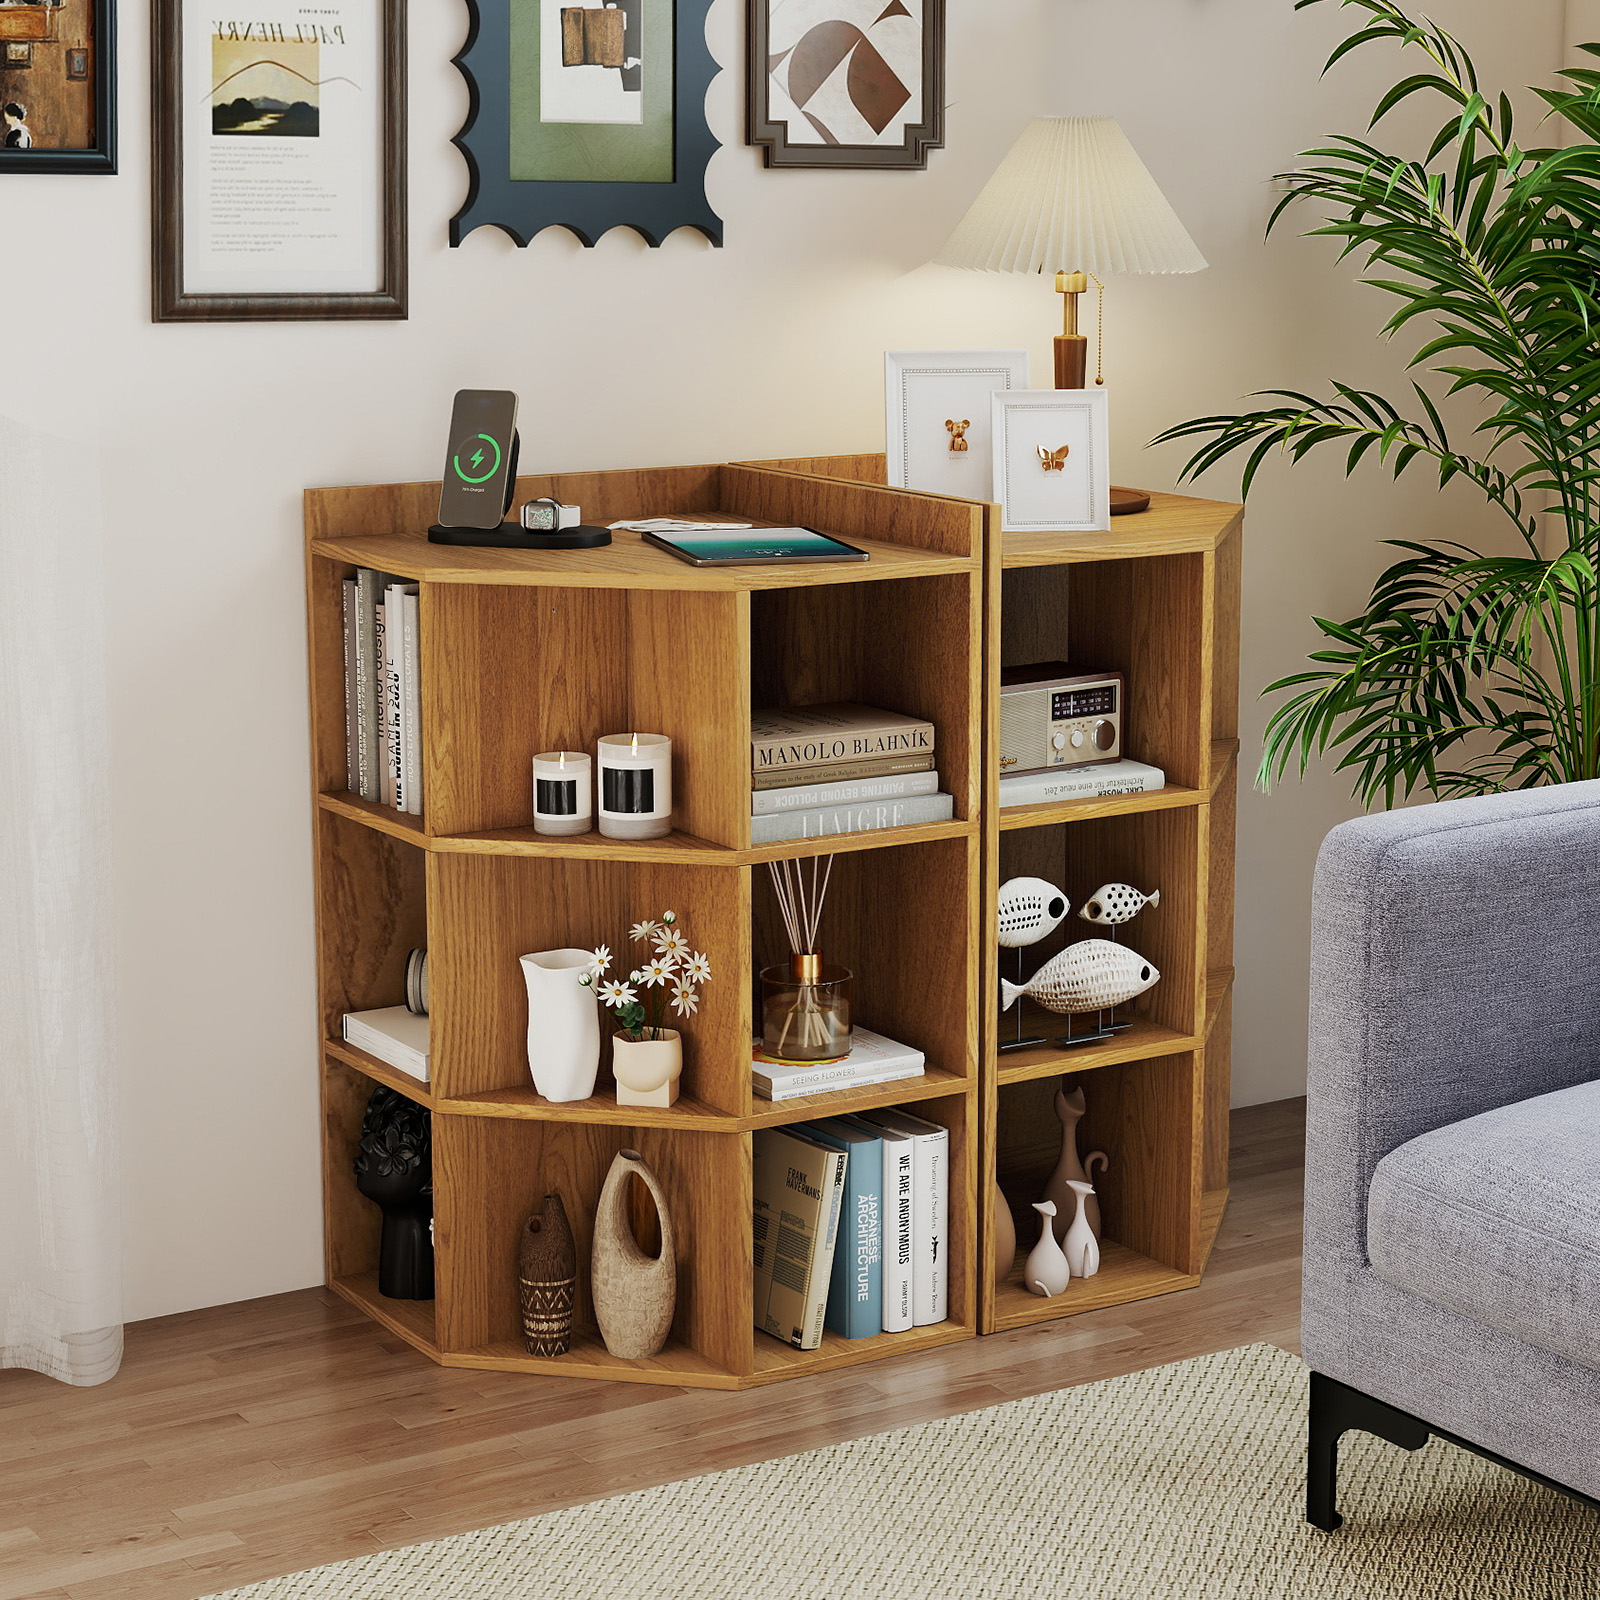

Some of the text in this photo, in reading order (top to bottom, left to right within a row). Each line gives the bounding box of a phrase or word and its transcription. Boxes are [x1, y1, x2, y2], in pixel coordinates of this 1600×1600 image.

[360, 647, 368, 710] arrangement
[404, 625, 414, 783] HOUSEHOLD DECORATES
[759, 729, 930, 767] MANOLO BLAHNÍK
[861, 782, 904, 797] PAINTING
[1043, 786, 1059, 796] Zeit
[1077, 783, 1093, 792] eine
[1105, 777, 1144, 789] Architektur
[774, 793, 816, 808] POLLOCK
[821, 787, 858, 802] BEYOND
[792, 1067, 856, 1086] SEEING FLOWERS
[787, 1167, 808, 1184] FRANK
[930, 1154, 940, 1191] Dreaming
[898, 1154, 911, 1265] WE ARE ANONYMOUS
[930, 1201, 939, 1230] Sweden
[868, 1193, 879, 1265] JAPANESE
[857, 1194, 869, 1302] ARCHITECTURE
[931, 1271, 939, 1293] Andrew
